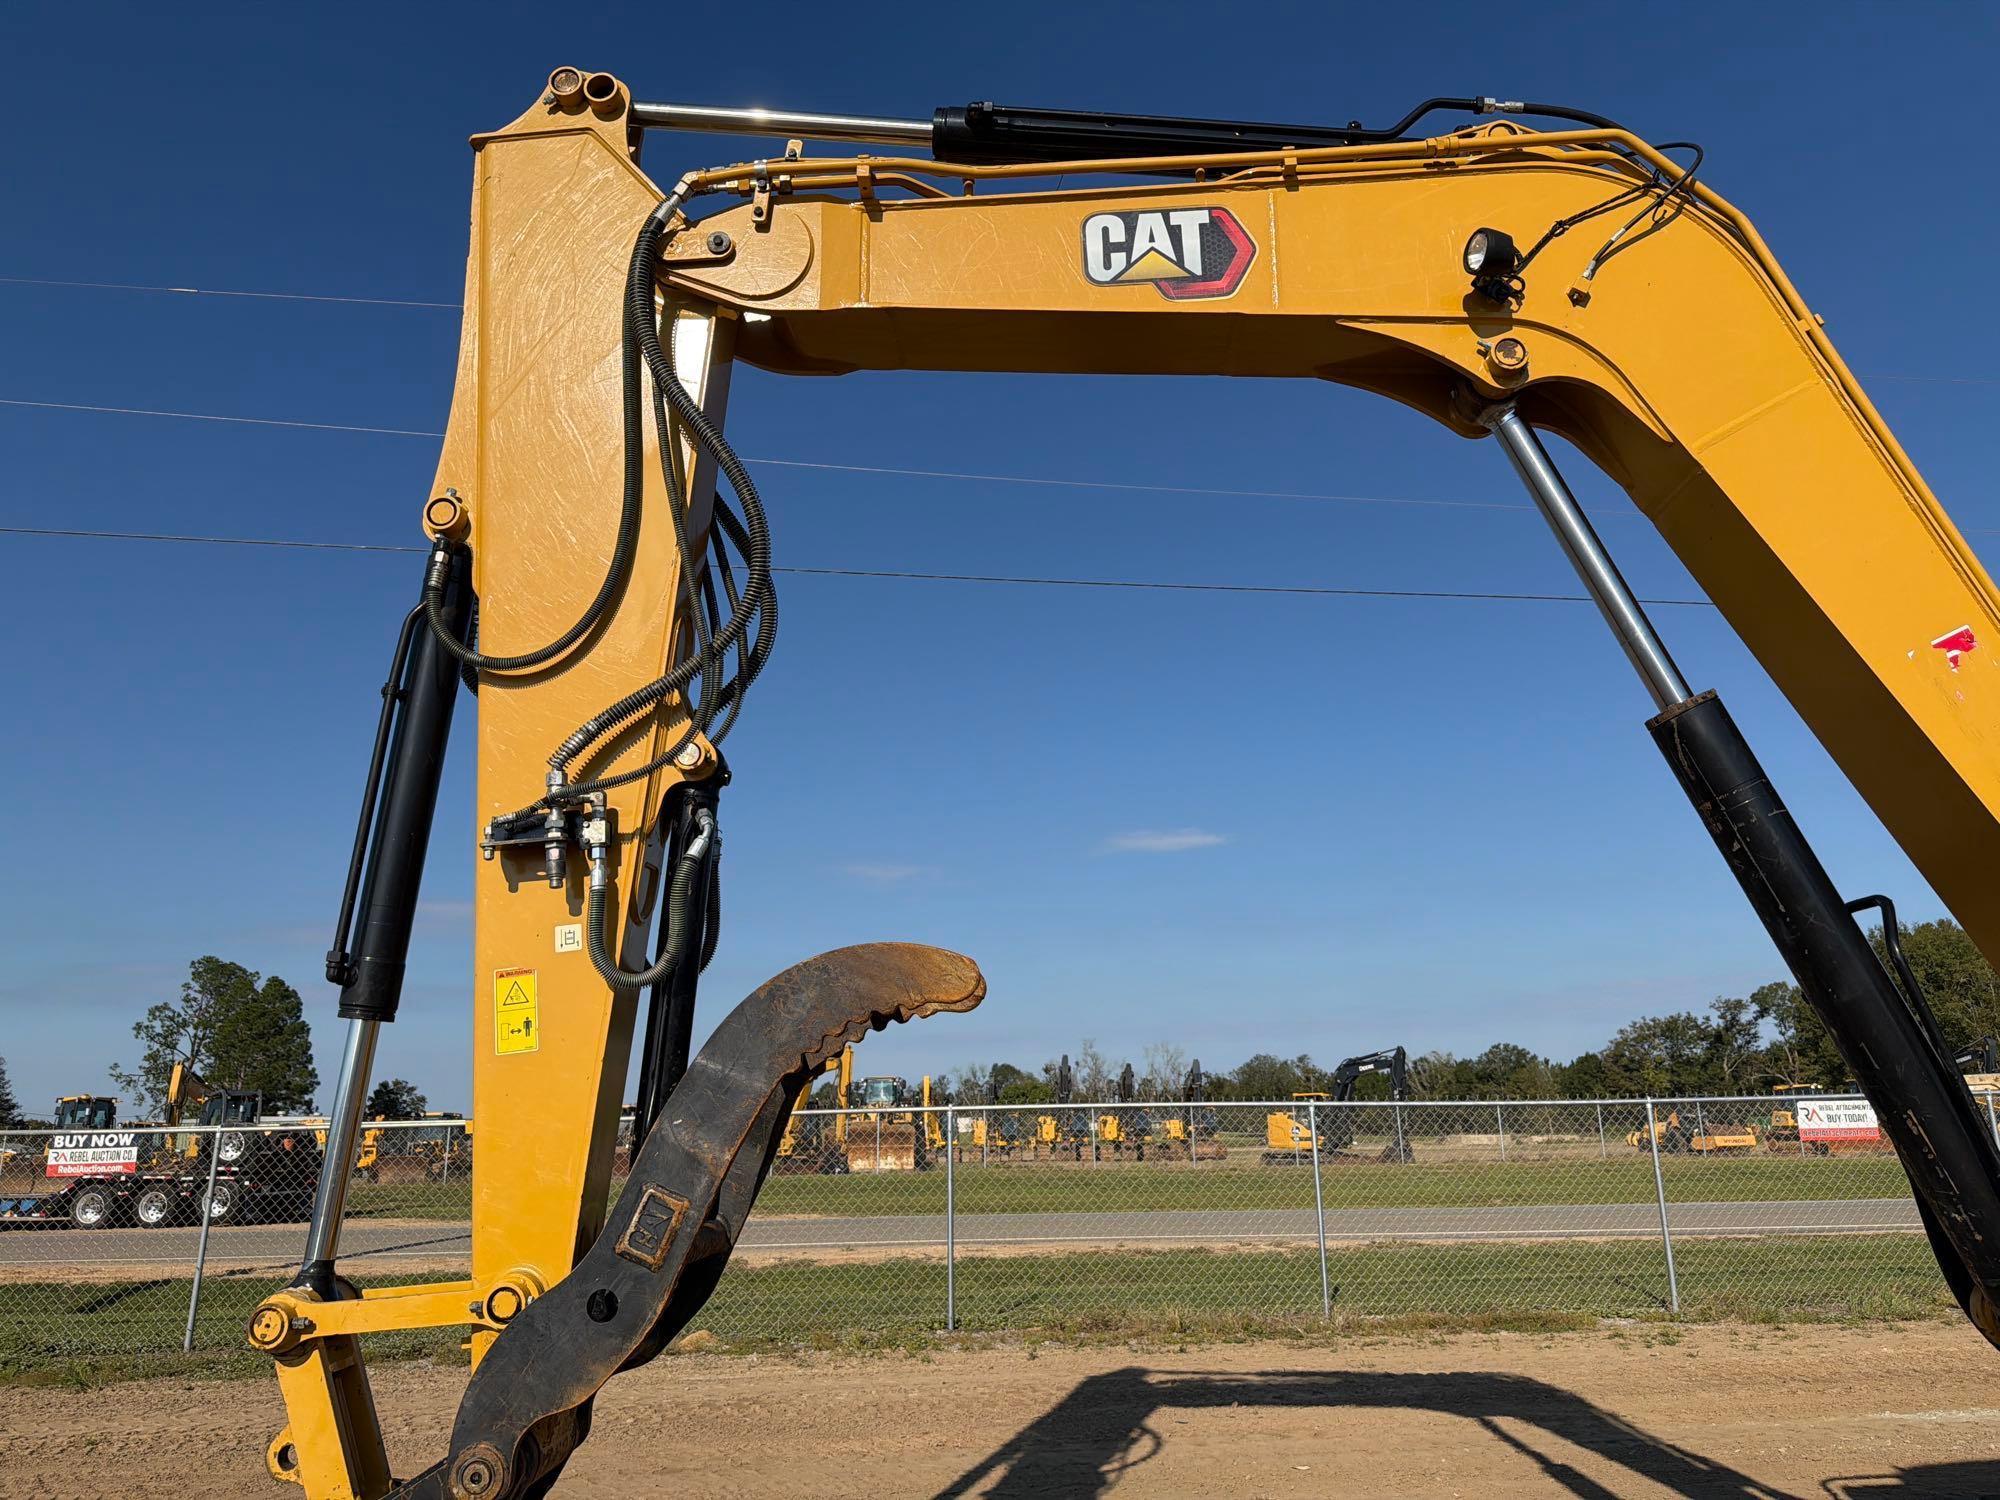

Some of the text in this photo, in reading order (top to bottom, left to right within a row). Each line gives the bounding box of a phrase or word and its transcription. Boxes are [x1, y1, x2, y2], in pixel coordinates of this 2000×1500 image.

[1085, 209, 1210, 282] CAT
[505, 969, 533, 977] WARNING
[1826, 1113, 1868, 1123] BUY TODAY!
[53, 1133, 135, 1148] BUY NOW
[69, 1149, 135, 1162] REBEL AUCTION CO.
[57, 1164, 123, 1174] RebelAuction.com
